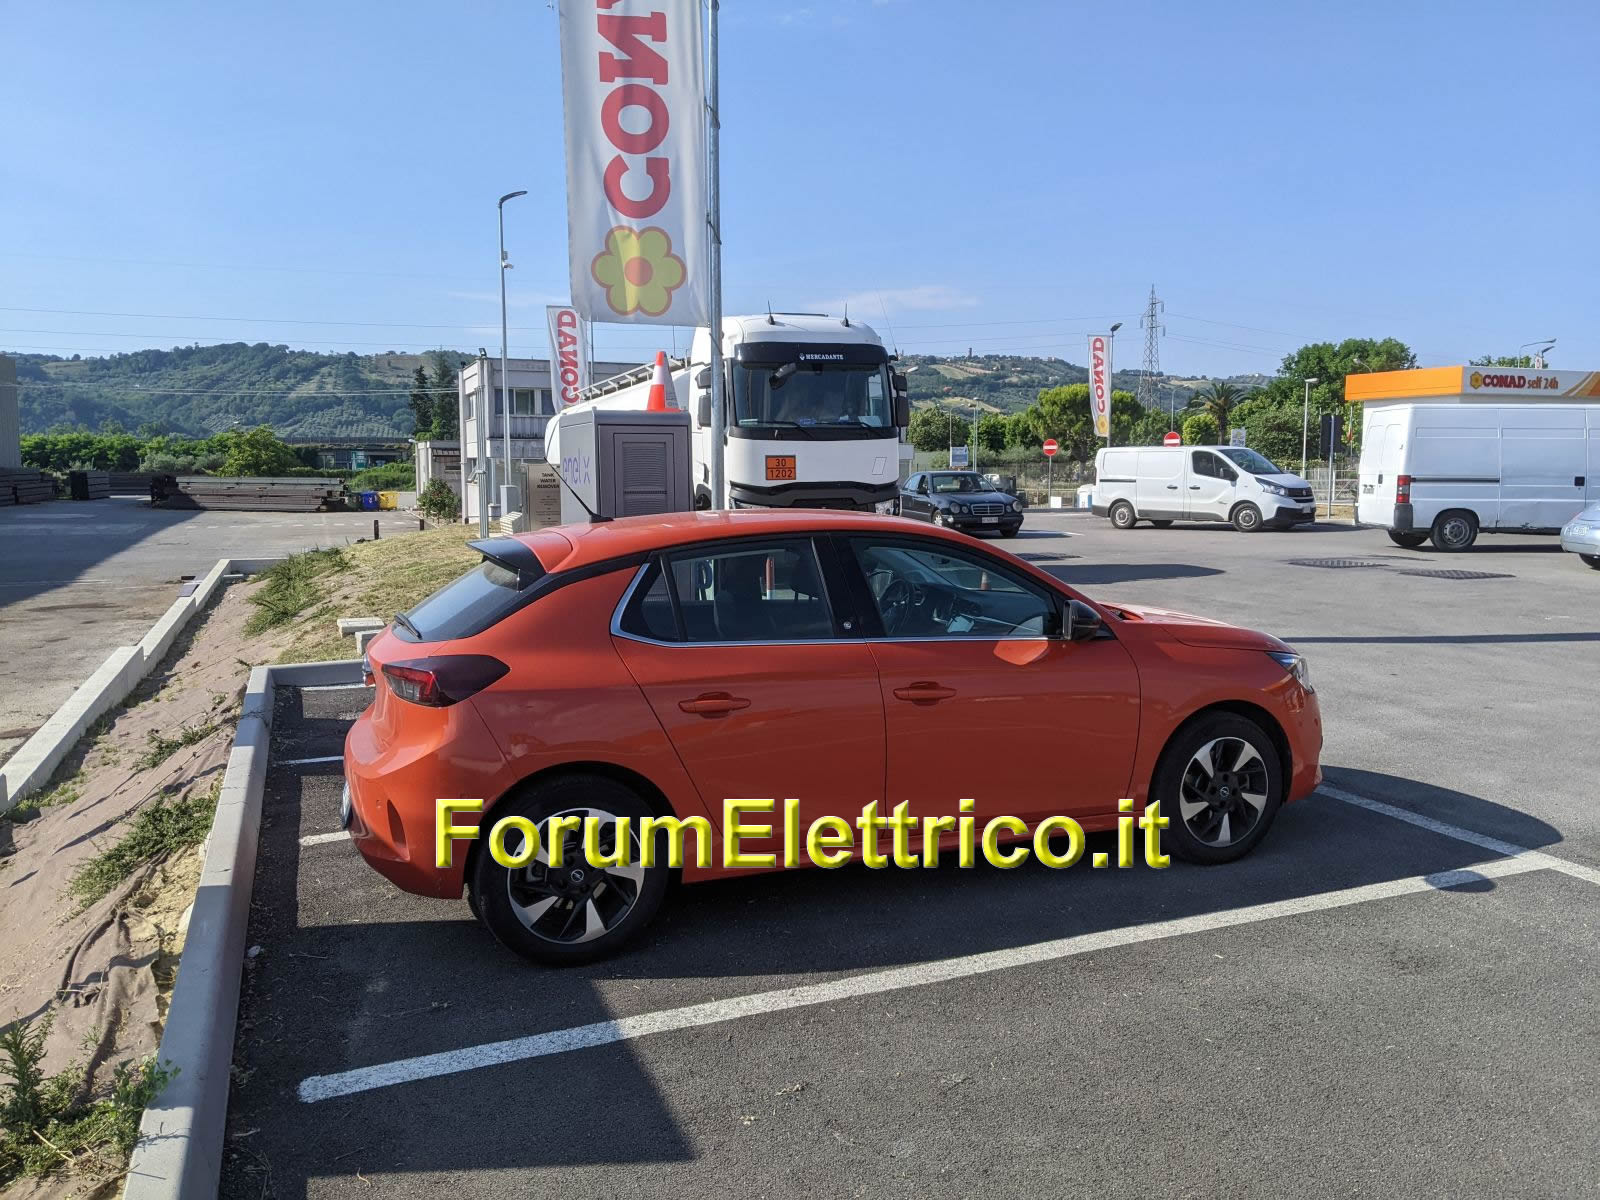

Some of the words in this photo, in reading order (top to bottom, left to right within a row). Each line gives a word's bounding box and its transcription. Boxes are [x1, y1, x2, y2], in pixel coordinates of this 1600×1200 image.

[1482, 374, 1527, 388] CONAD
[1527, 375, 1542, 389] self
[1544, 376, 1559, 389] 24h
[562, 448, 581, 484] enel
[775, 458, 787, 467] 30
[770, 469, 793, 478] 1202
